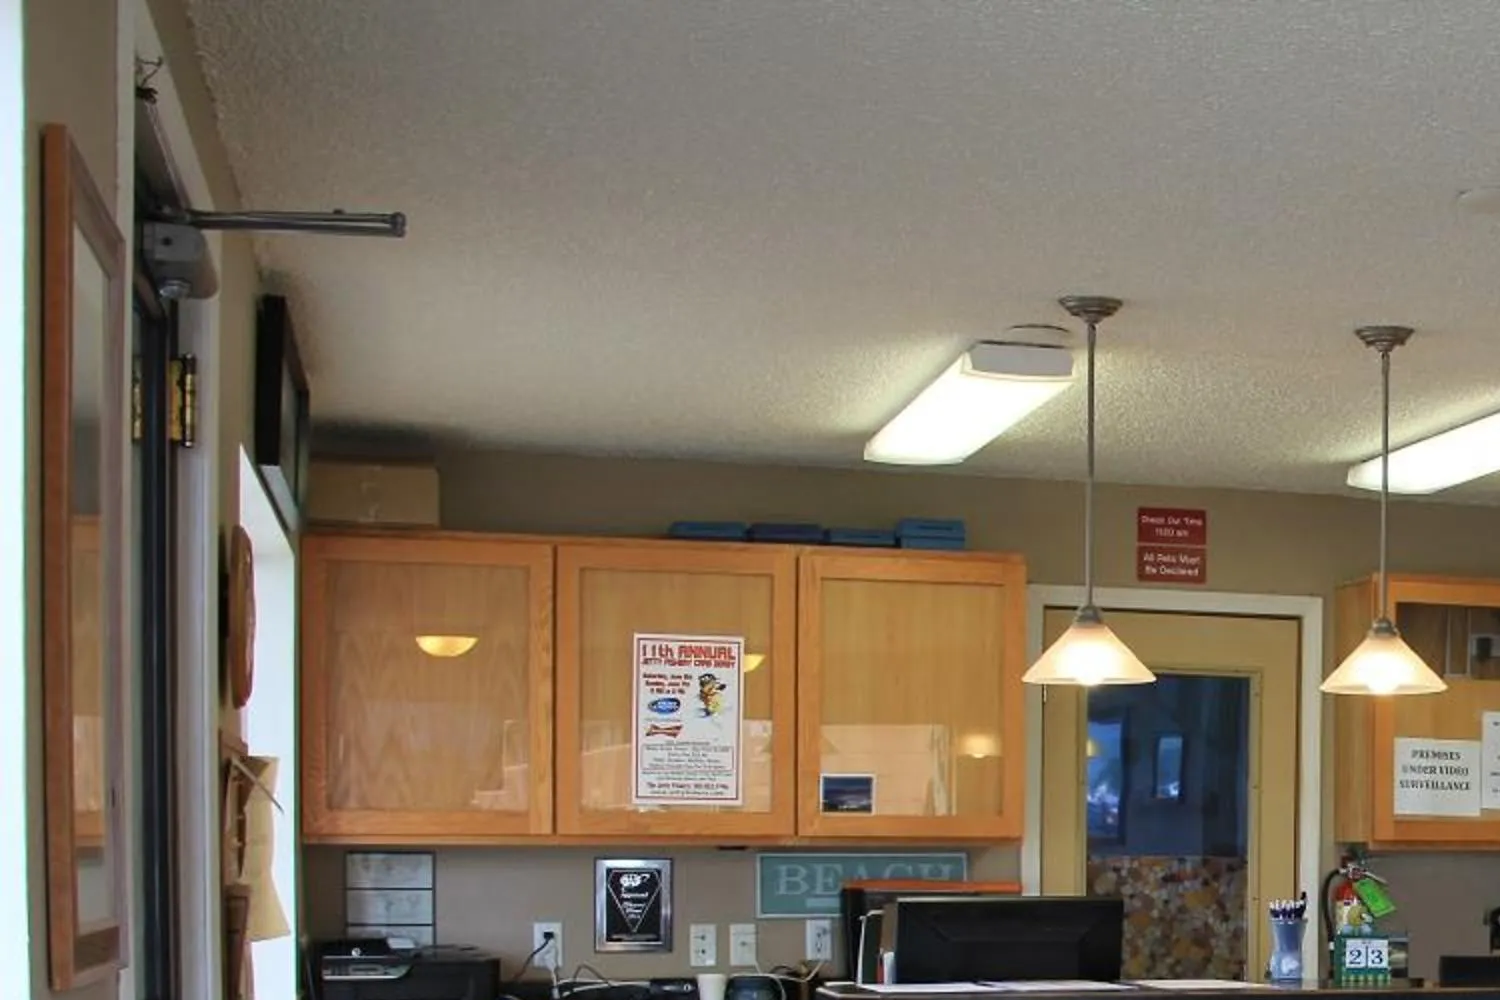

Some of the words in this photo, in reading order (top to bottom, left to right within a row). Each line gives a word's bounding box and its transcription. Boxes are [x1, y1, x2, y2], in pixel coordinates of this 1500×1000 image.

[642, 644, 674, 657] 11th
[678, 645, 736, 660] ANNUAL
[1411, 749, 1461, 760] PREMISES
[1402, 765, 1437, 775] UNDER
[1439, 766, 1469, 776] VIDEO
[1399, 779, 1471, 791] SURVEILLANCE
